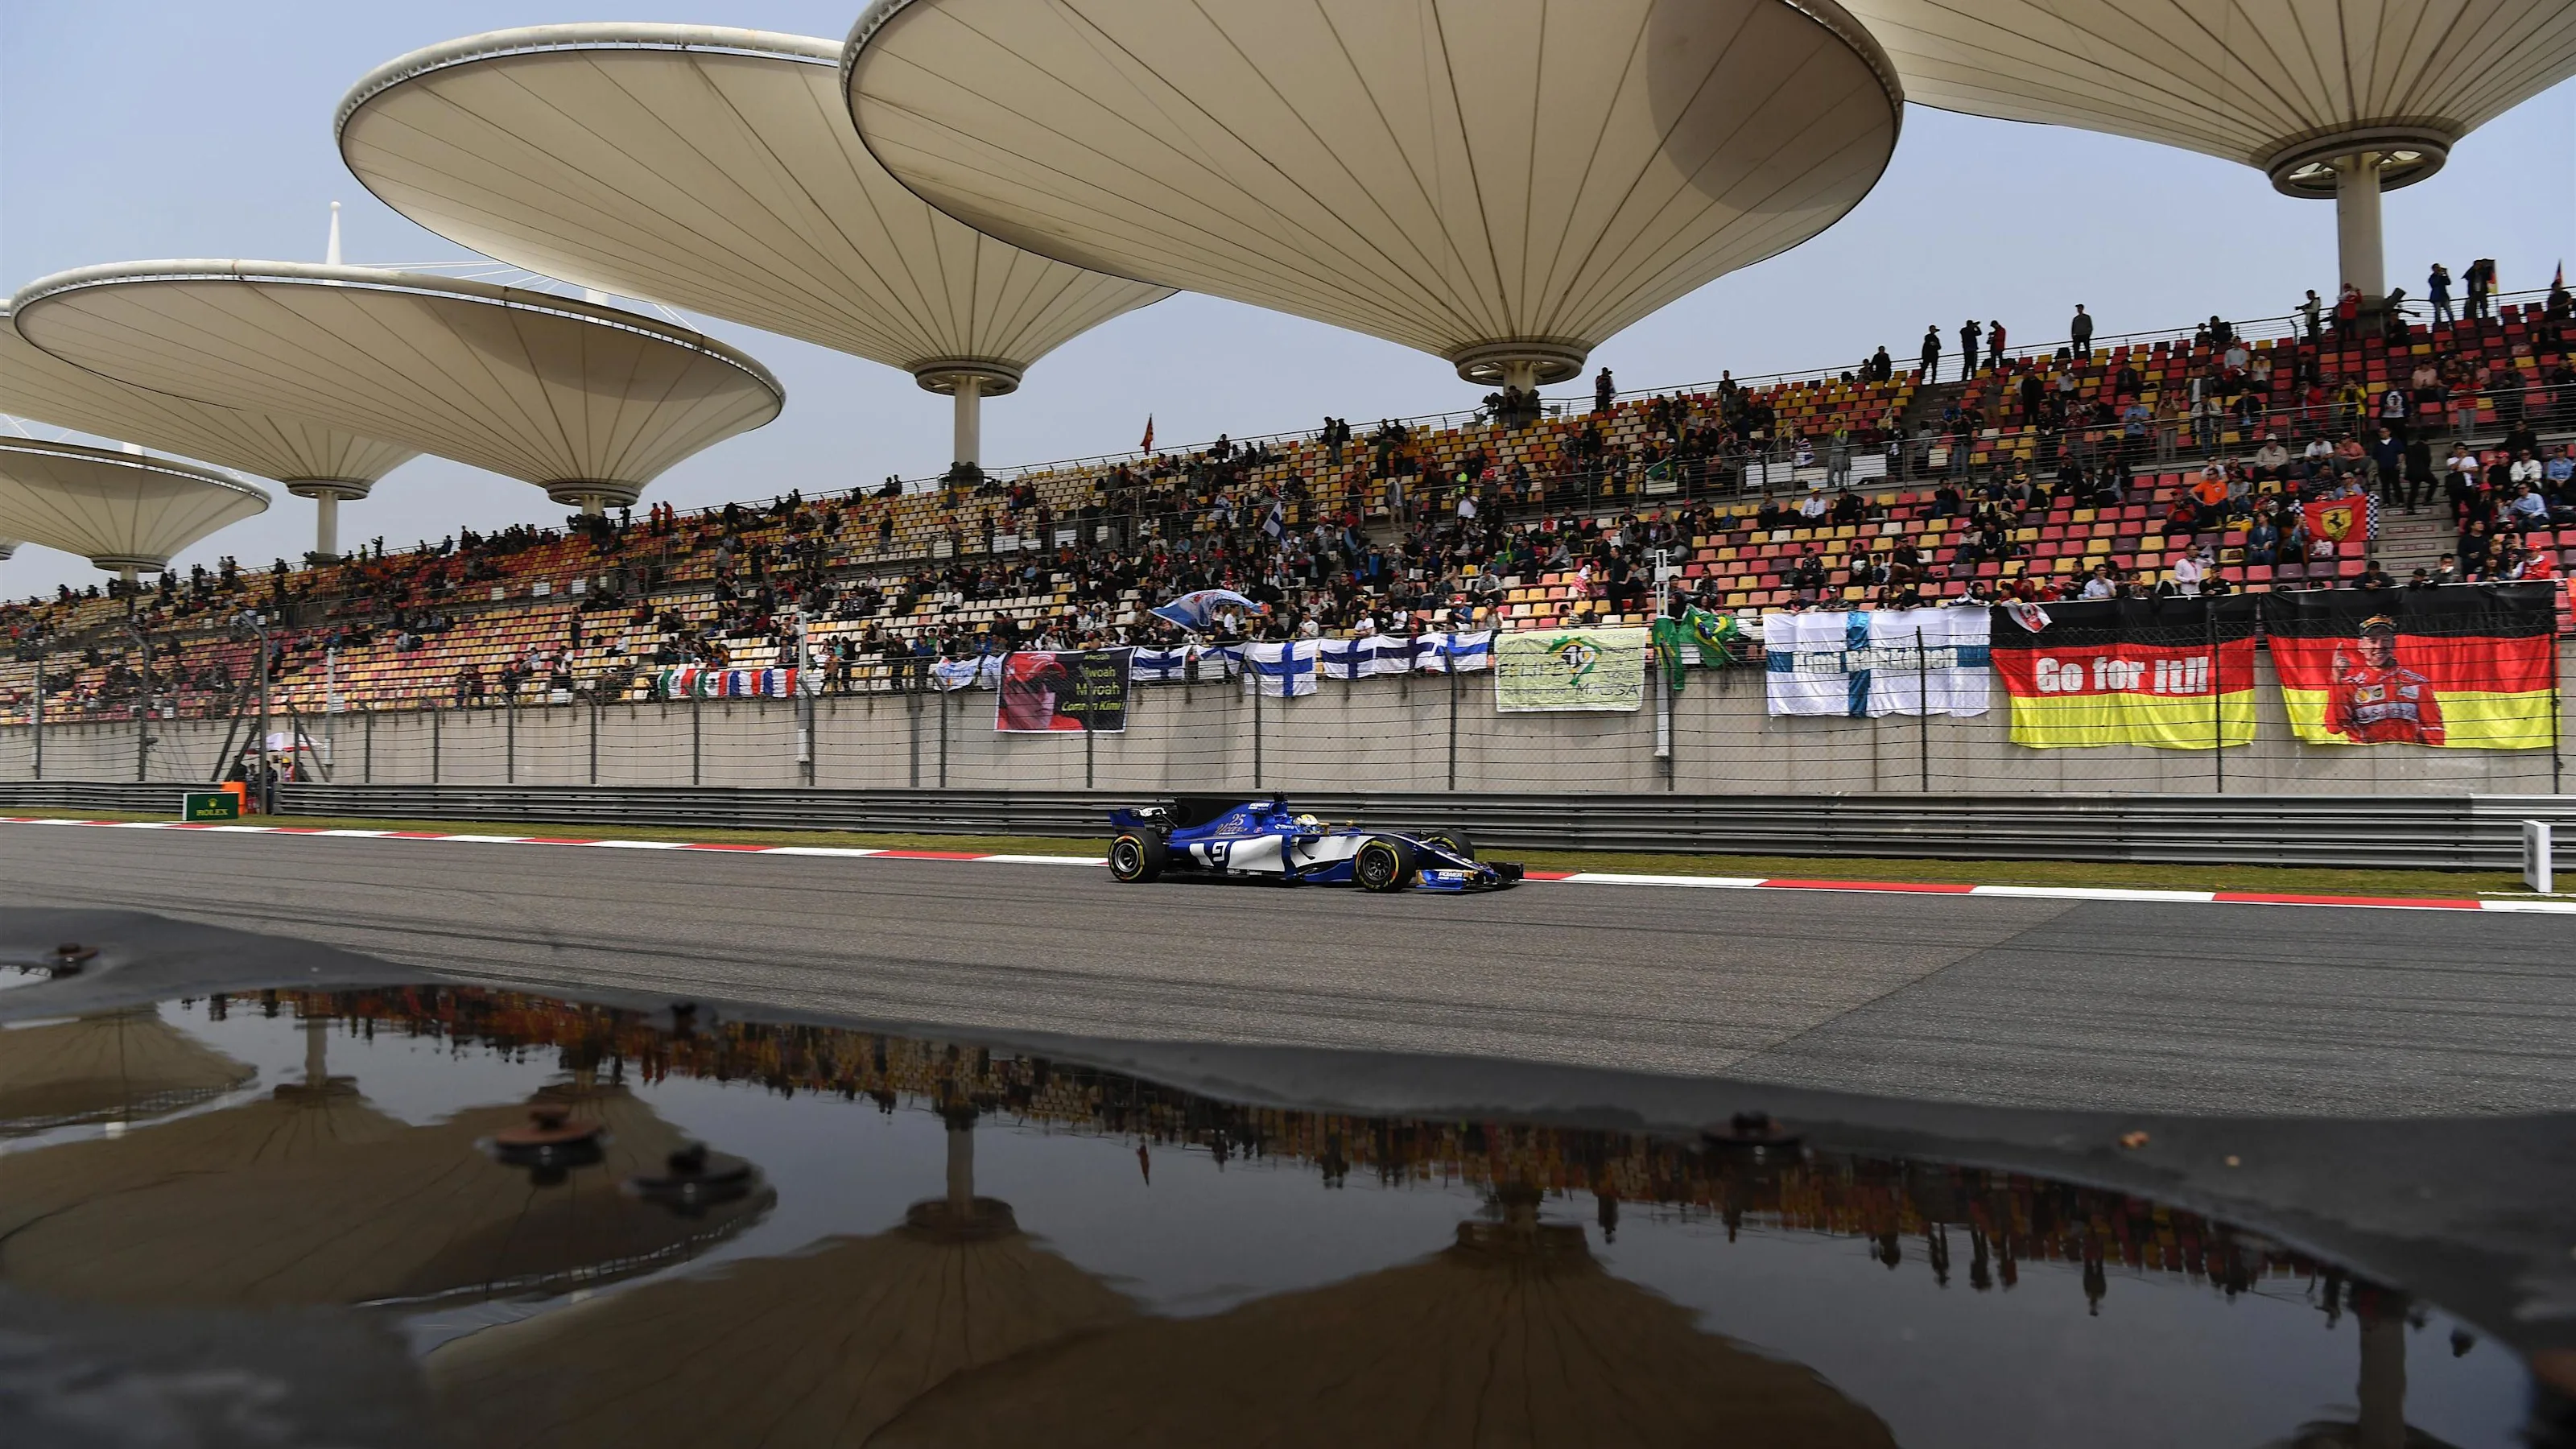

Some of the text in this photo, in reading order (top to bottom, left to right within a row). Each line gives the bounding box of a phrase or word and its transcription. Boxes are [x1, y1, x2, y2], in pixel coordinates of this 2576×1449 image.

[2036, 657, 2084, 693] Go
[2093, 656, 2145, 691] for
[196, 808, 229, 816] ROLEX
[1230, 813, 1246, 826] 25
[1212, 841, 1229, 861] 9
